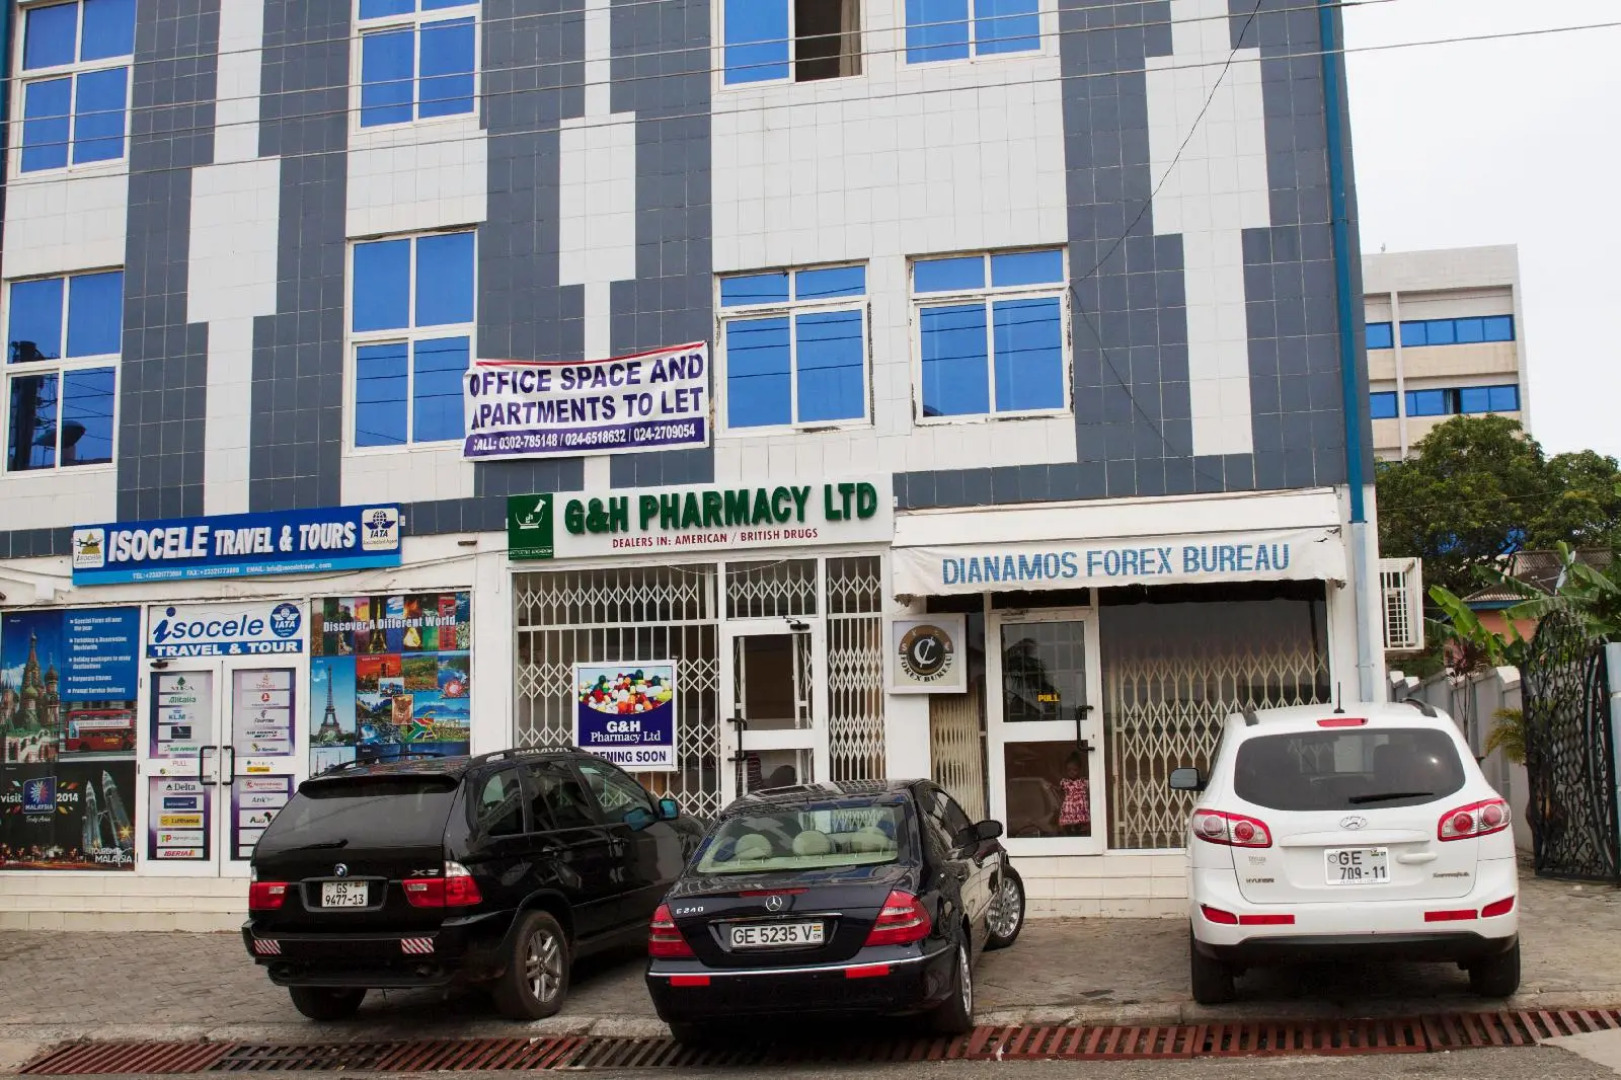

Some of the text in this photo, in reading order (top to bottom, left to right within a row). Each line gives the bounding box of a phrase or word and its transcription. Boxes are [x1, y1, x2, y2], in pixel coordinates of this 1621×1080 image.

[470, 354, 704, 397] OFFICE SPACE AND
[623, 392, 653, 417] TO
[661, 387, 703, 414] LET
[499, 434, 557, 450] 0302-785148
[565, 429, 626, 446] 024-6518632
[634, 423, 695, 441] 024-2709054
[565, 482, 877, 535] G&H PHARMACY LTD
[108, 521, 357, 562] ISOCELE TRAVEL & TOURS
[370, 530, 388, 538] IATA
[612, 528, 818, 548] DEALERS IN: AMERICAN / BRITISH DRUGS
[942, 544, 1289, 585] DIANAMOS FOREX BUREAU
[153, 606, 264, 643] isocele
[275, 620, 296, 628] IATA
[378, 616, 423, 629] Different
[155, 641, 298, 657] TRAVEL & TOUR
[606, 721, 641, 733] G&H
[590, 730, 661, 744] Pharmacy Ltd
[636, 750, 666, 762] SOON
[0, 793, 79, 803] visit 2014
[1338, 851, 1362, 866] GE
[336, 882, 348, 894] GS
[325, 894, 364, 905] 9477-13
[733, 925, 812, 944] GE 5235 V
